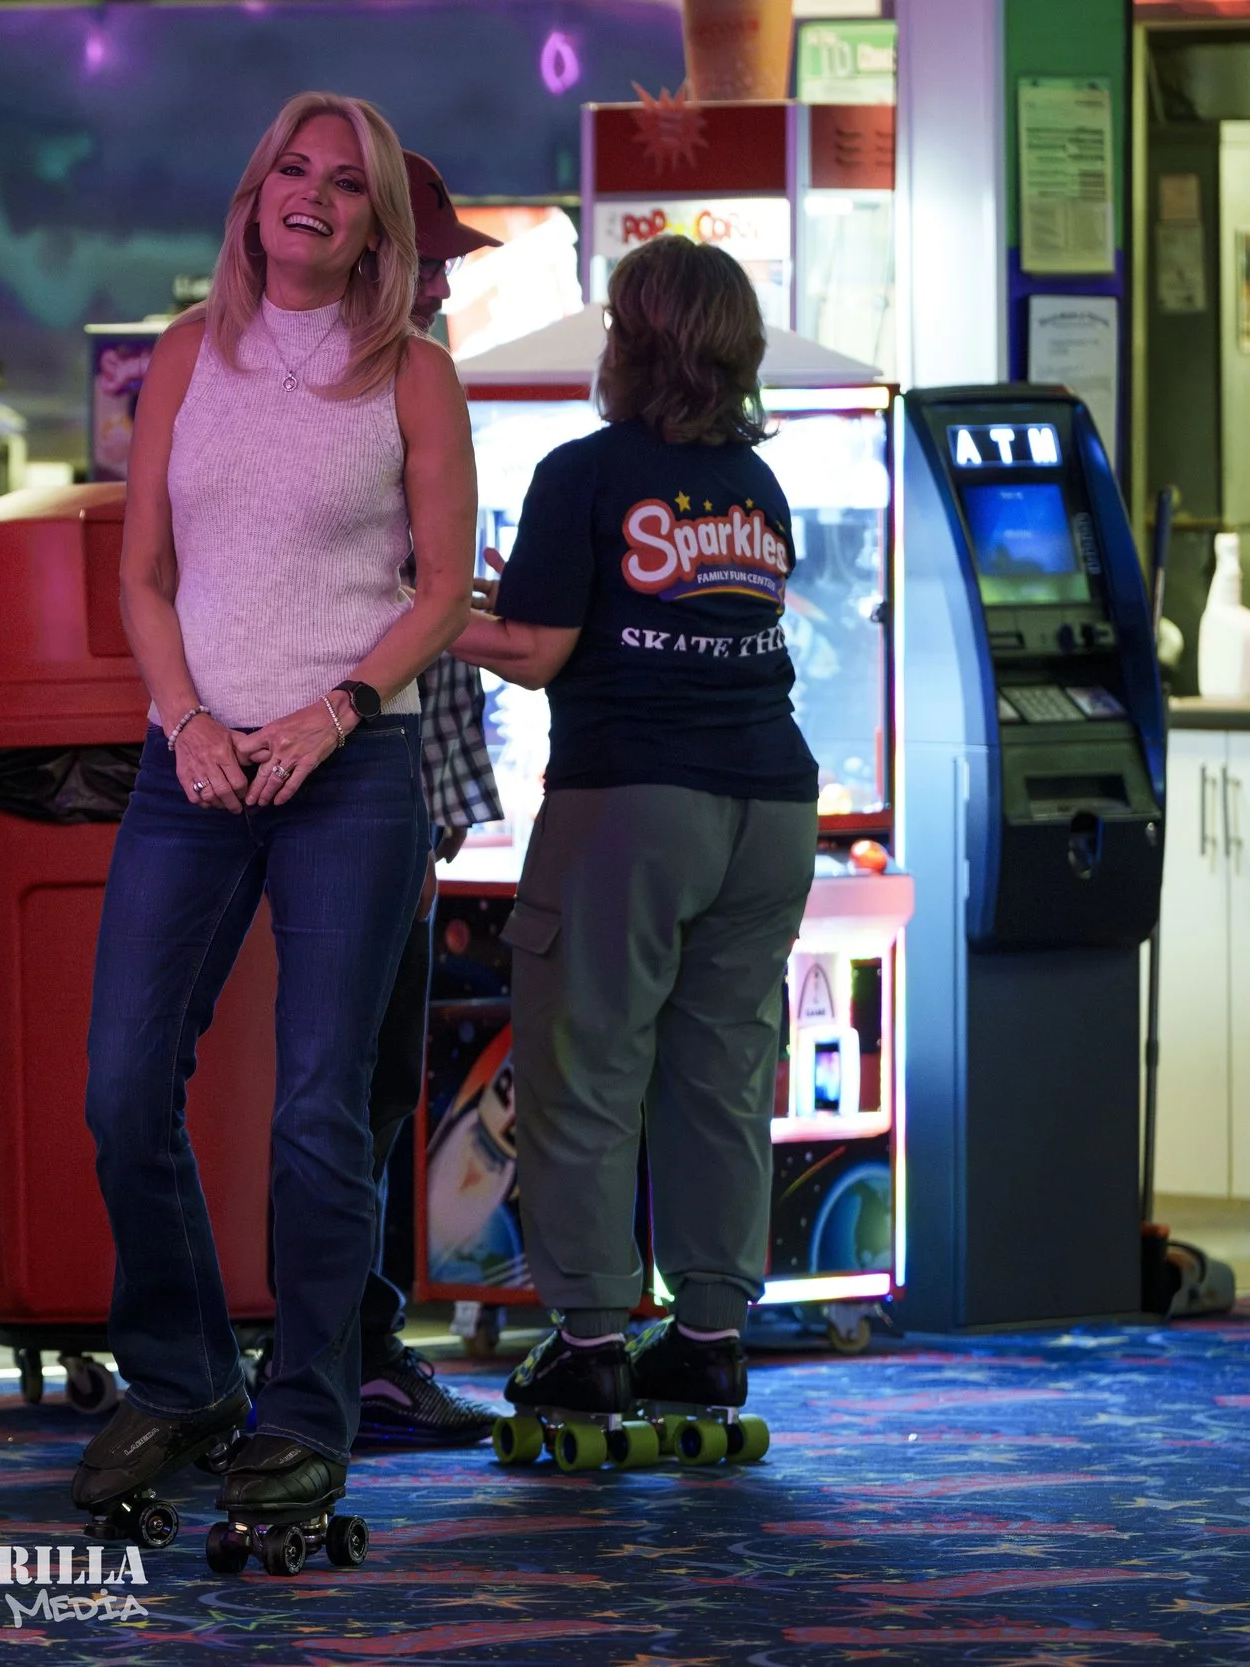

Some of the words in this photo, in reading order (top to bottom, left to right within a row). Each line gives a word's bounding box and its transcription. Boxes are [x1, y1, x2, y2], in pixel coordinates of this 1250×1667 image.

[622, 208, 667, 244] POP
[956, 427, 1058, 465] ATM
[627, 504, 788, 583] Sparkles
[697, 570, 729, 584] FAMILY
[730, 570, 747, 582] FUN
[621, 626, 733, 658] SKATE
